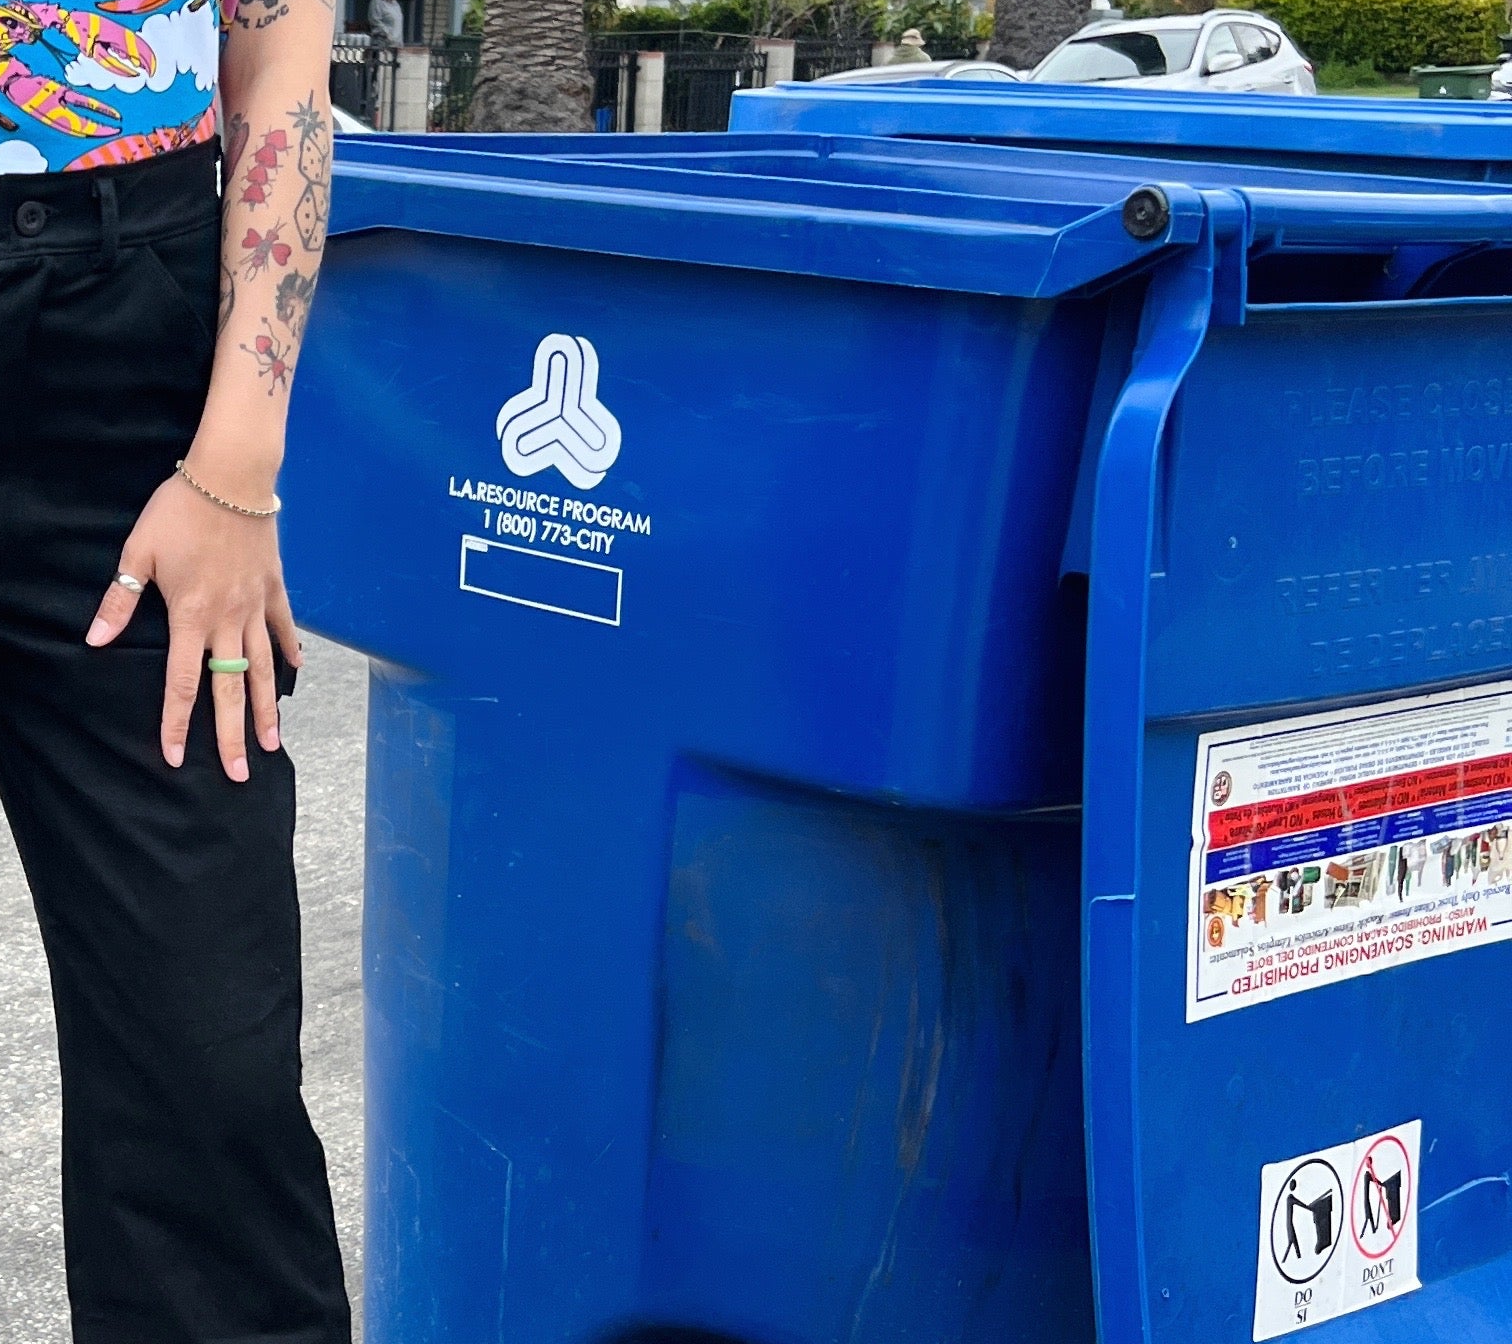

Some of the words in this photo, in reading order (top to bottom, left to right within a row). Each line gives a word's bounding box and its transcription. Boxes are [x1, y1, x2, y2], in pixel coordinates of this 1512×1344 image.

[1283, 384, 1413, 426] PLEASE
[1298, 449, 1429, 495] BEFORE
[1441, 442, 1512, 484] MOV
[563, 498, 651, 535] PROGRAM
[483, 508, 491, 529] 1
[496, 510, 537, 542] (800)
[541, 520, 615, 555] 773-CITY
[1391, 914, 1442, 934] PROHIBIDO
[1418, 916, 1487, 945] WARNING:
[1276, 950, 1294, 962] DEL
[1298, 934, 1354, 957] CONTENIDO
[1324, 933, 1413, 970] SCAVENGING
[1231, 957, 1319, 995] PROHIBITED
[1247, 956, 1273, 971] BOTE
[1294, 1287, 1313, 1306] DO
[1368, 1281, 1385, 1299] NO
